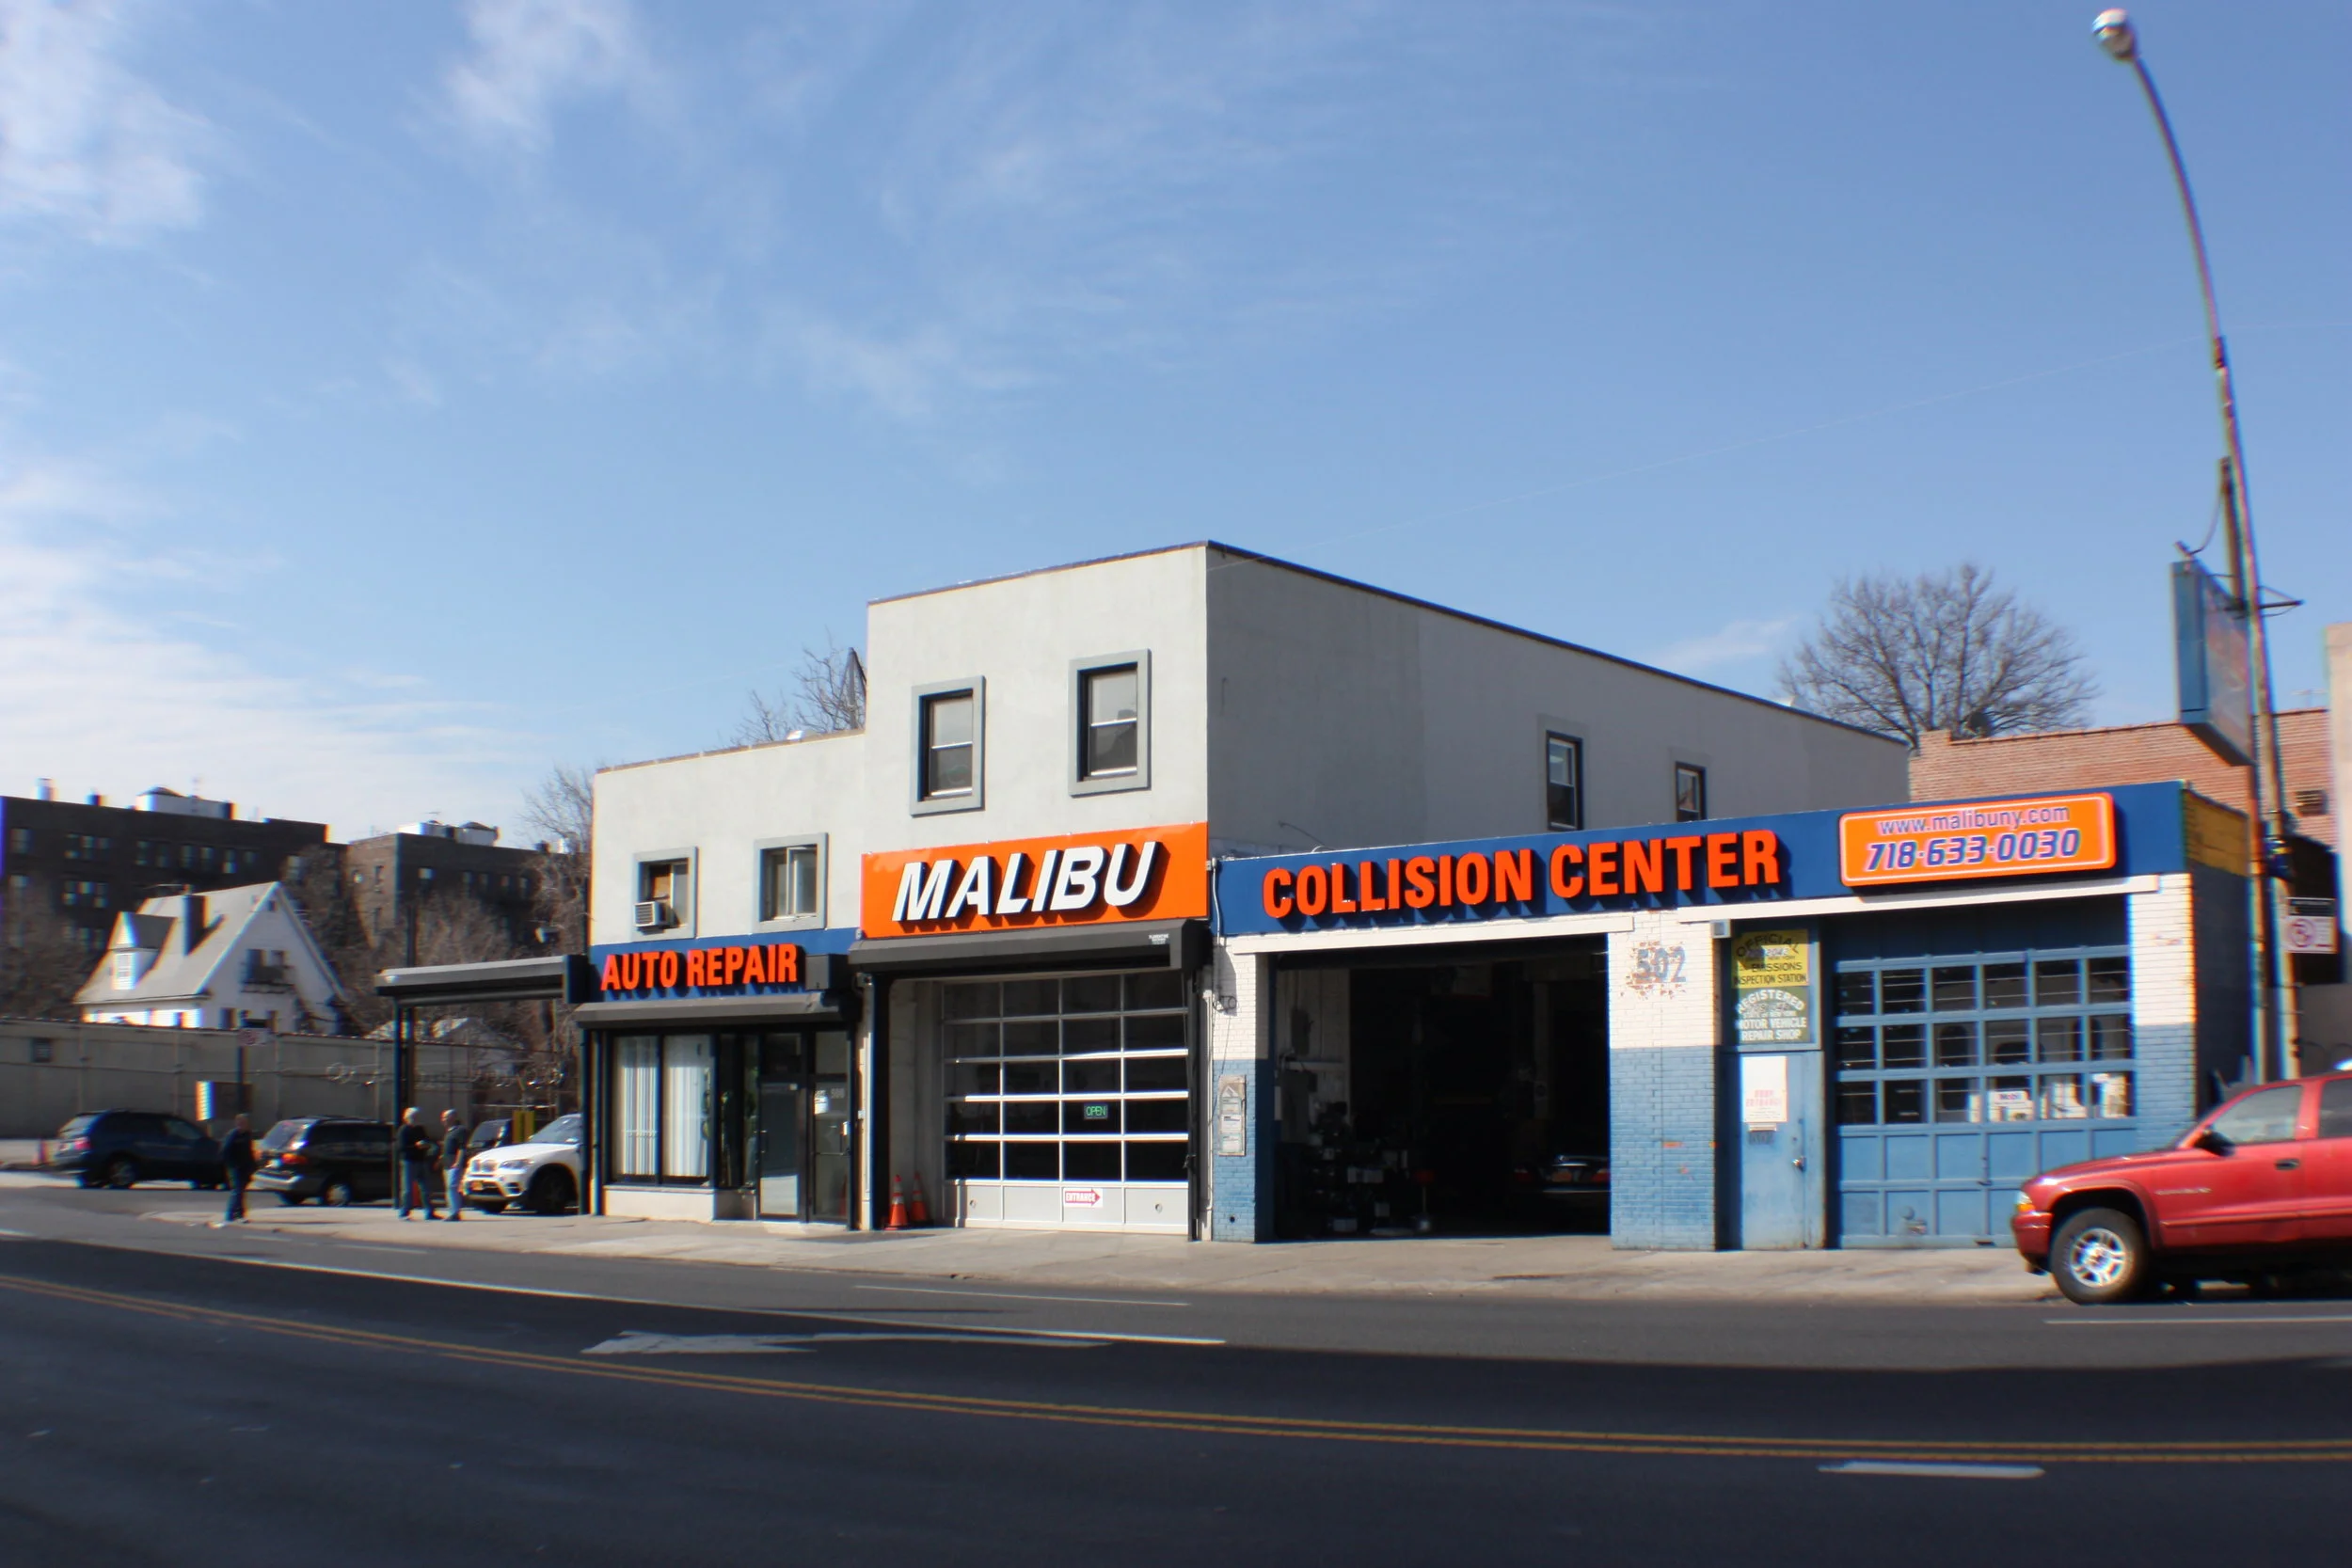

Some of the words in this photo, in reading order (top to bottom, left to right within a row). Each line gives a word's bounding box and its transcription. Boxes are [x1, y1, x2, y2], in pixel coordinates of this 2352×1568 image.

[1880, 806, 2069, 835] www.malibuny.com
[891, 841, 1157, 922] MALIBU
[1263, 848, 1533, 919] COLLISION
[1550, 829, 1779, 898] CENTER
[1736, 933, 1799, 958] OFFICIAL
[600, 949, 678, 990] AUTO
[687, 943, 798, 987] REPAIR
[1637, 945, 1687, 983] 502
[1751, 962, 1803, 973] EMISSIONS
[1777, 973, 1806, 983] STATION
[1738, 989, 1805, 1014] REGISTERED
[1736, 1019, 1769, 1030] MOTOR
[1770, 1017, 1807, 1028] VEHICLE
[1741, 1030, 1774, 1041] REPAIR
[1775, 1028, 1802, 1040] SHOP
[1086, 1105, 1106, 1117] OPEN
[1066, 1192, 1096, 1201] ENTRANCE
